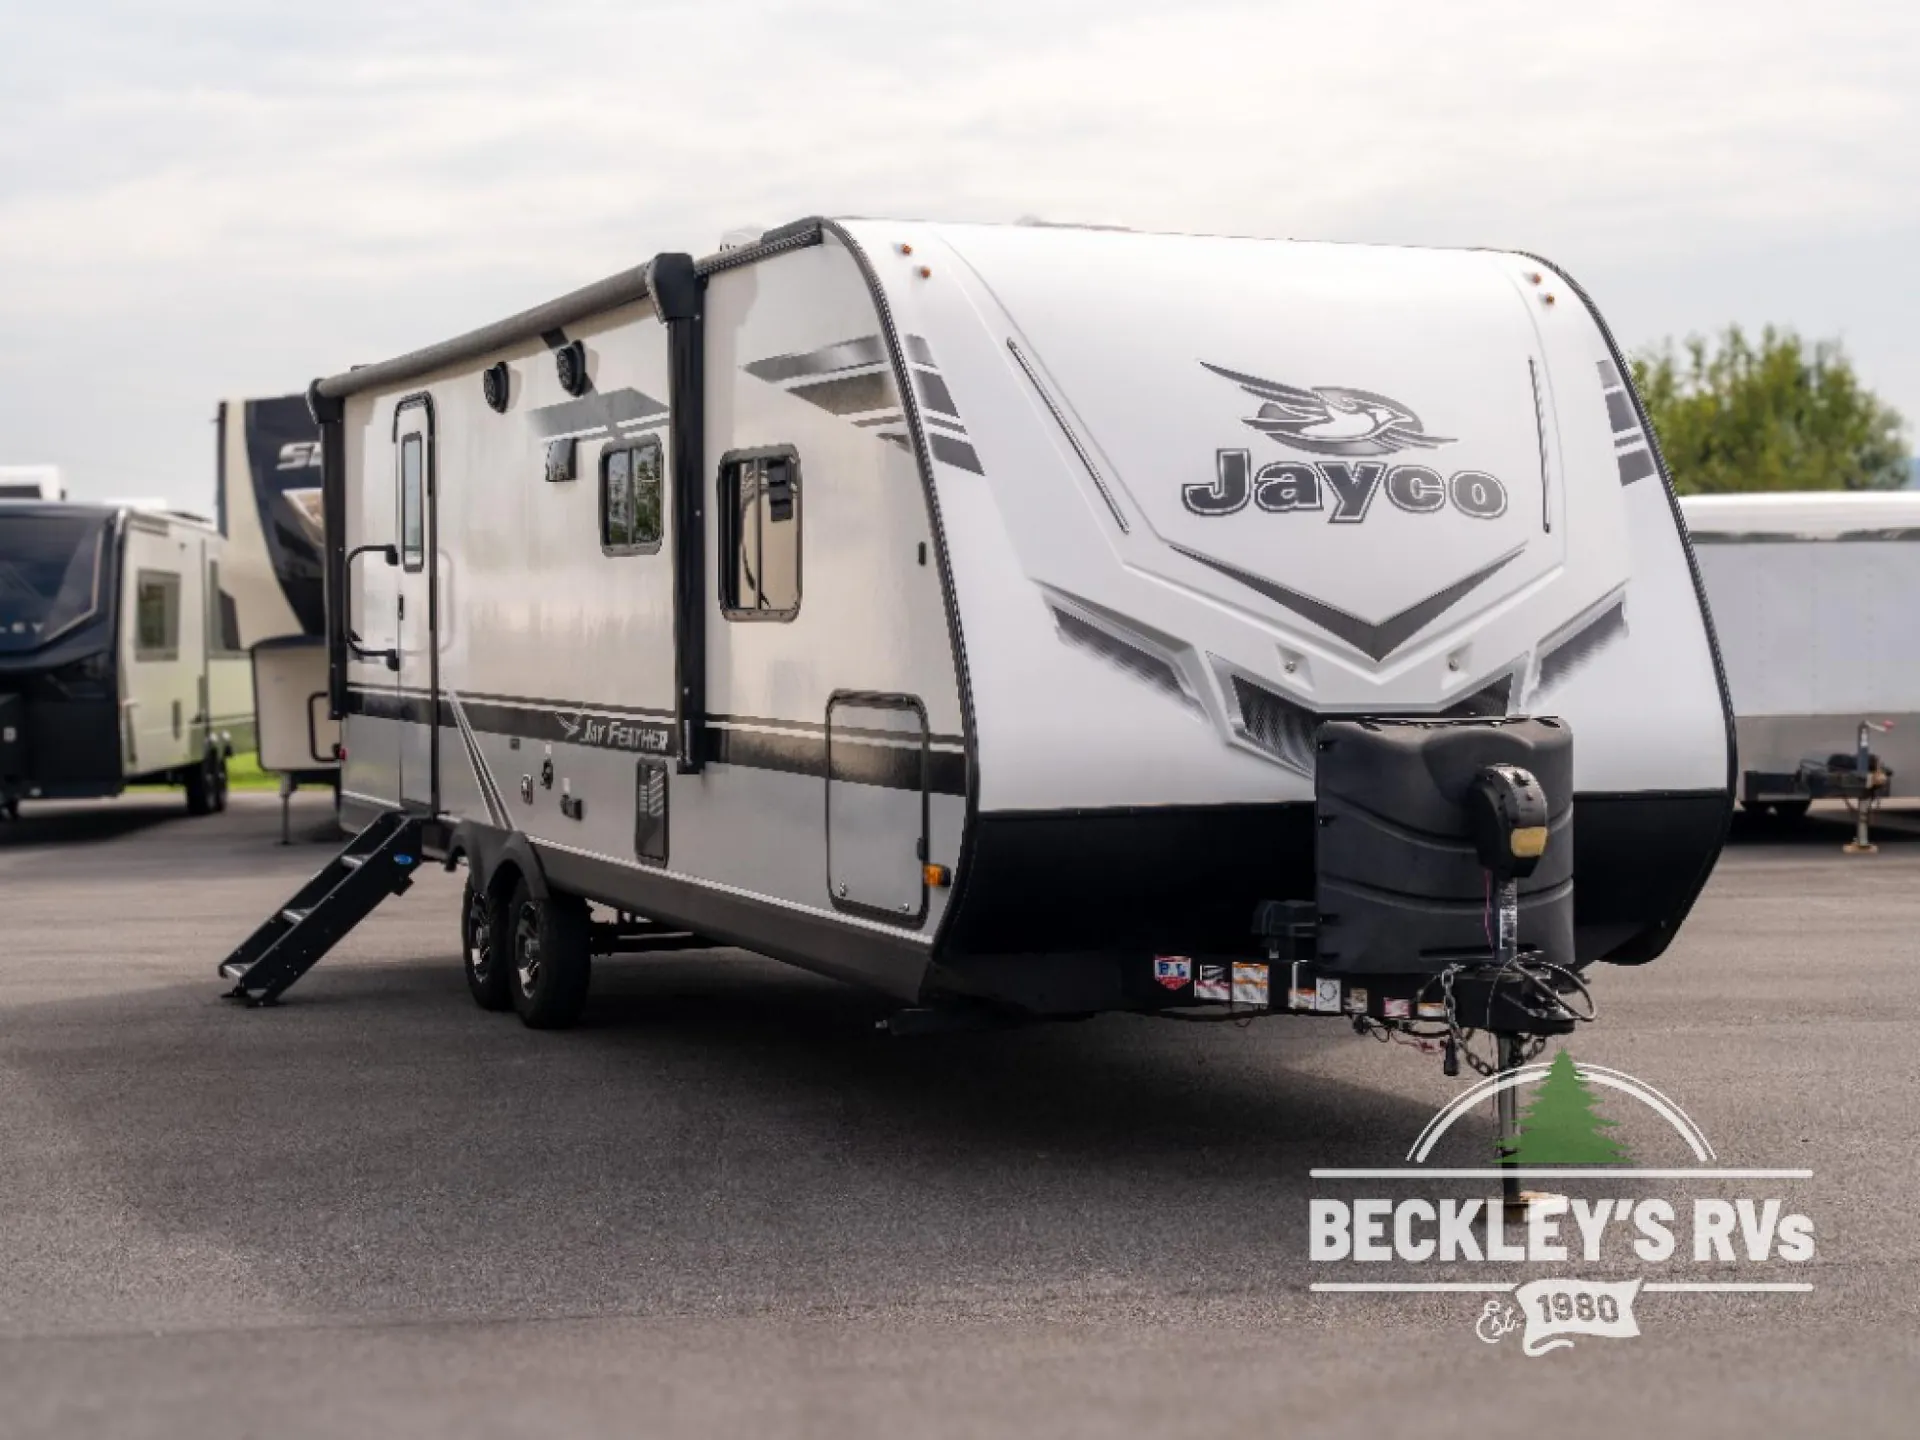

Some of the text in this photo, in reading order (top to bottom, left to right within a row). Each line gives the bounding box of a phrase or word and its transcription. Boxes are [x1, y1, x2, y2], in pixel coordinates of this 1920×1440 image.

[1182, 448, 1508, 523] Jayco
[579, 719, 669, 751] JAY FEATHER
